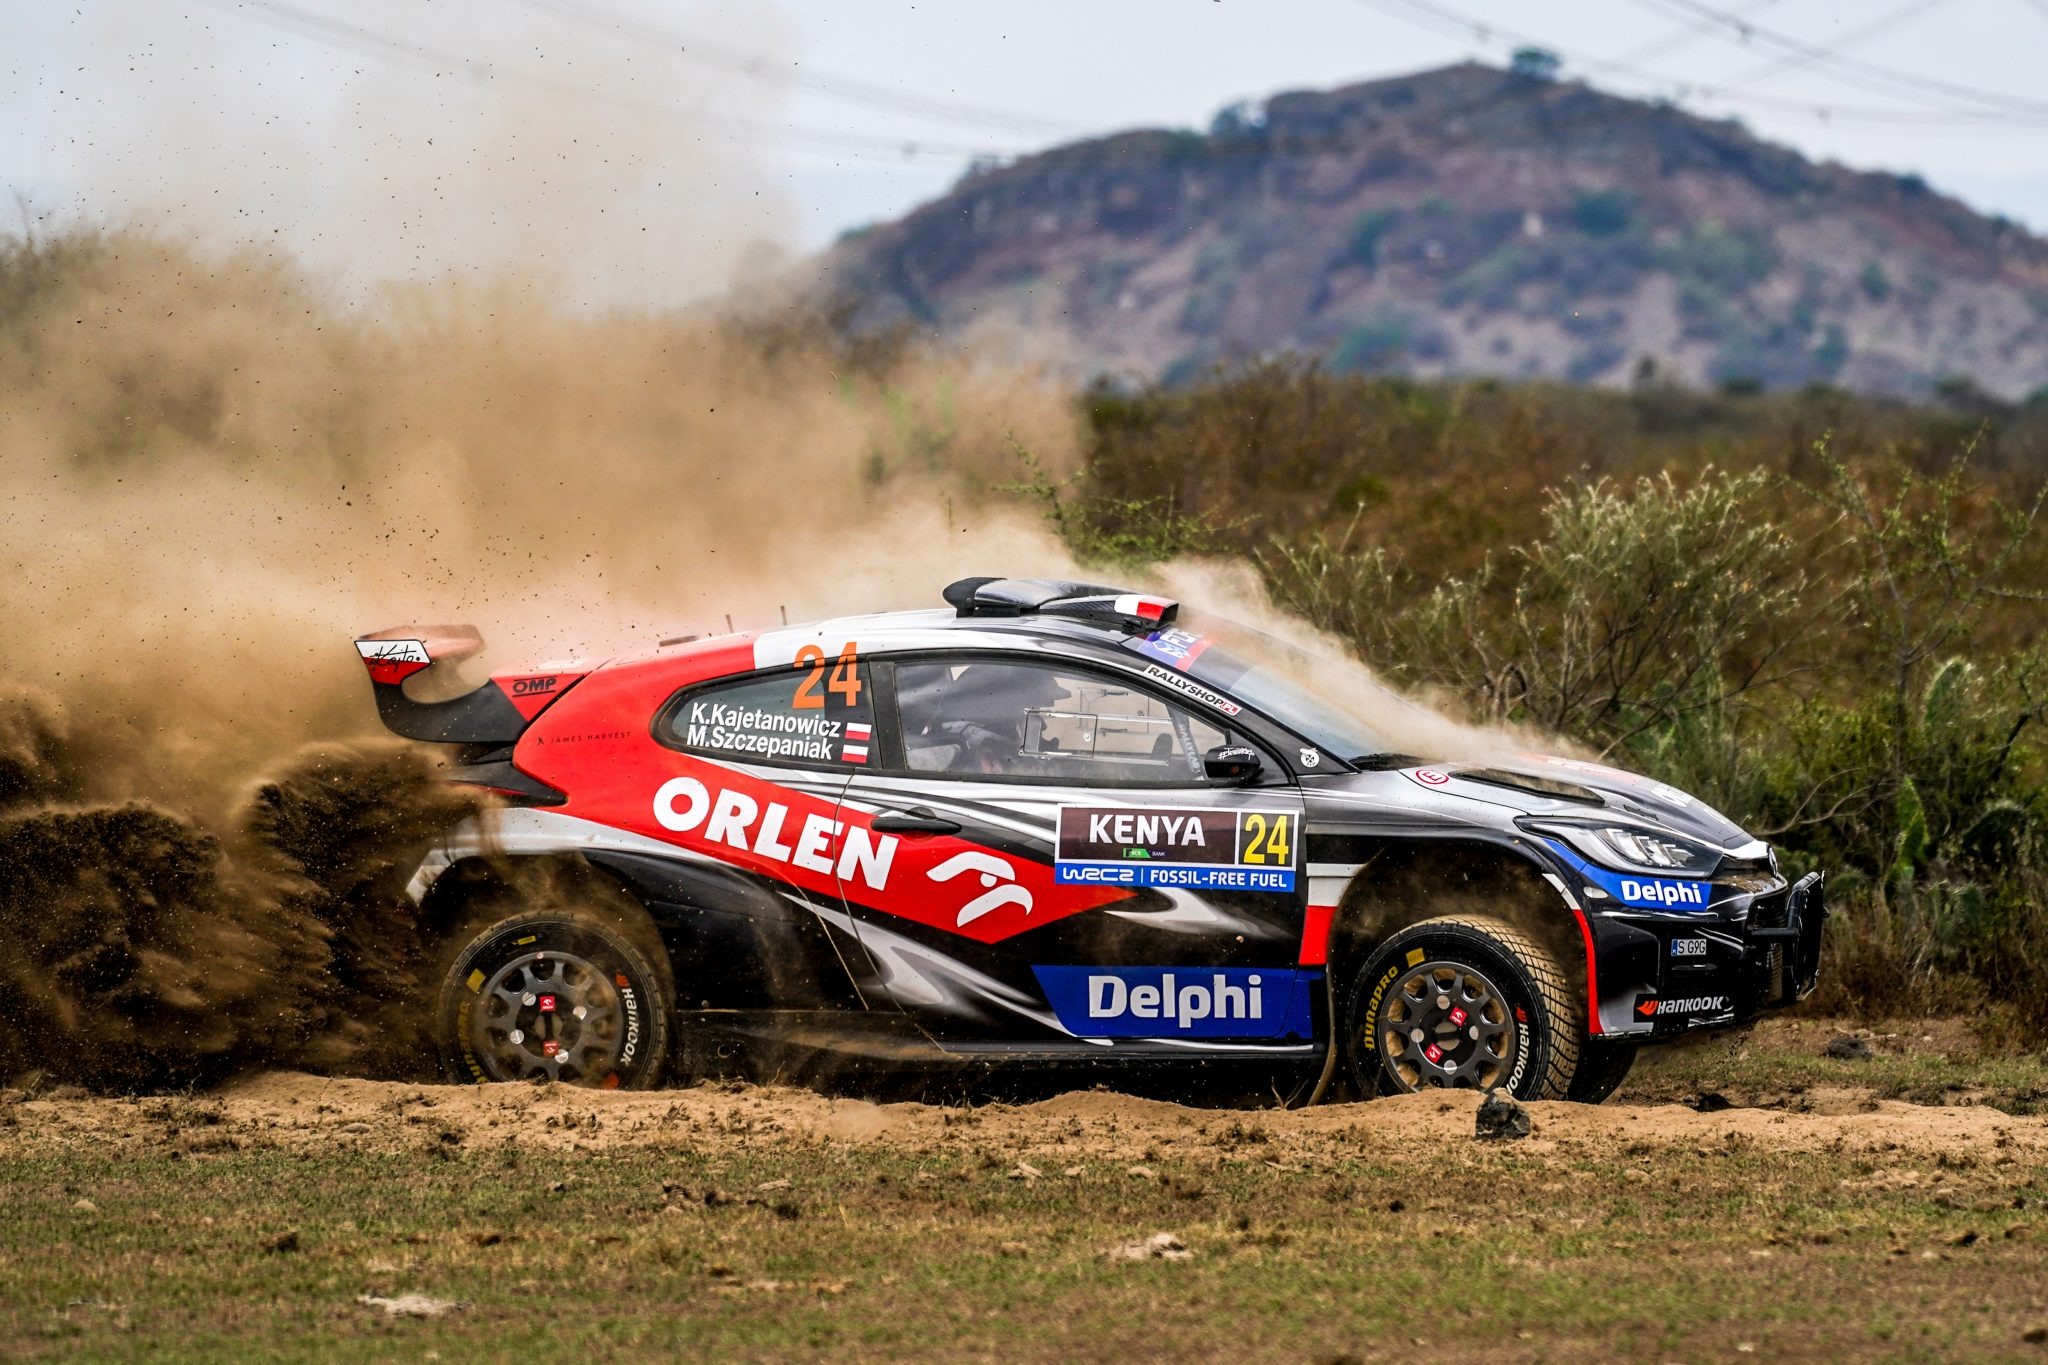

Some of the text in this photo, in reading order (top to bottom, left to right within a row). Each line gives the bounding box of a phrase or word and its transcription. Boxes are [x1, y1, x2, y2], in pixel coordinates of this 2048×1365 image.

[512, 677, 557, 694] OMP
[792, 641, 862, 710] 24
[551, 731, 631, 744] JAMES HARVEST
[690, 701, 842, 738] K.Kajetanowicz
[686, 724, 833, 760] M.Szczepaniak
[652, 776, 900, 892] ORLEN
[1089, 814, 1206, 847] KENYA
[1243, 813, 1290, 865] 24
[1062, 866, 1288, 889] WRC2 FOSSIL-FREE FUEL
[1620, 880, 1703, 906] Delphi
[1088, 973, 1263, 1029] Delphi
